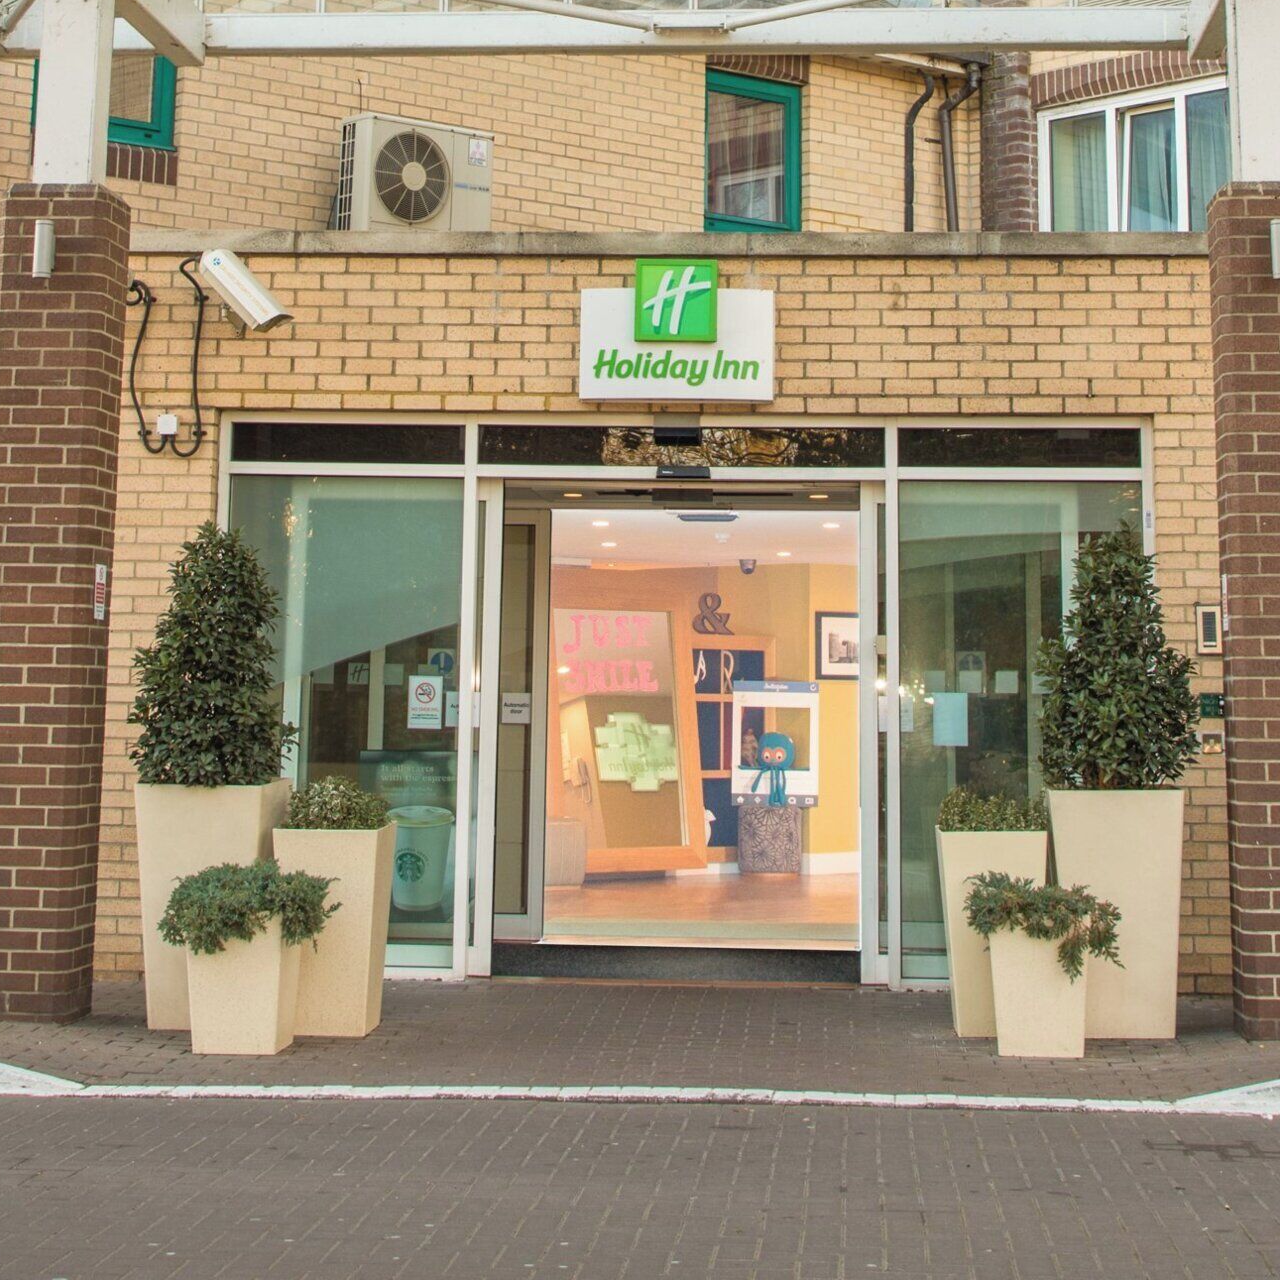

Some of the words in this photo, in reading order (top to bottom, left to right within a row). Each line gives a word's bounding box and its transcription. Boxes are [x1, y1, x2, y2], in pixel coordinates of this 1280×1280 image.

[593, 348, 709, 387] Holiday
[712, 349, 760, 381] Inn
[692, 592, 735, 635] &
[563, 614, 652, 654] JUST
[560, 659, 660, 693] SMILE
